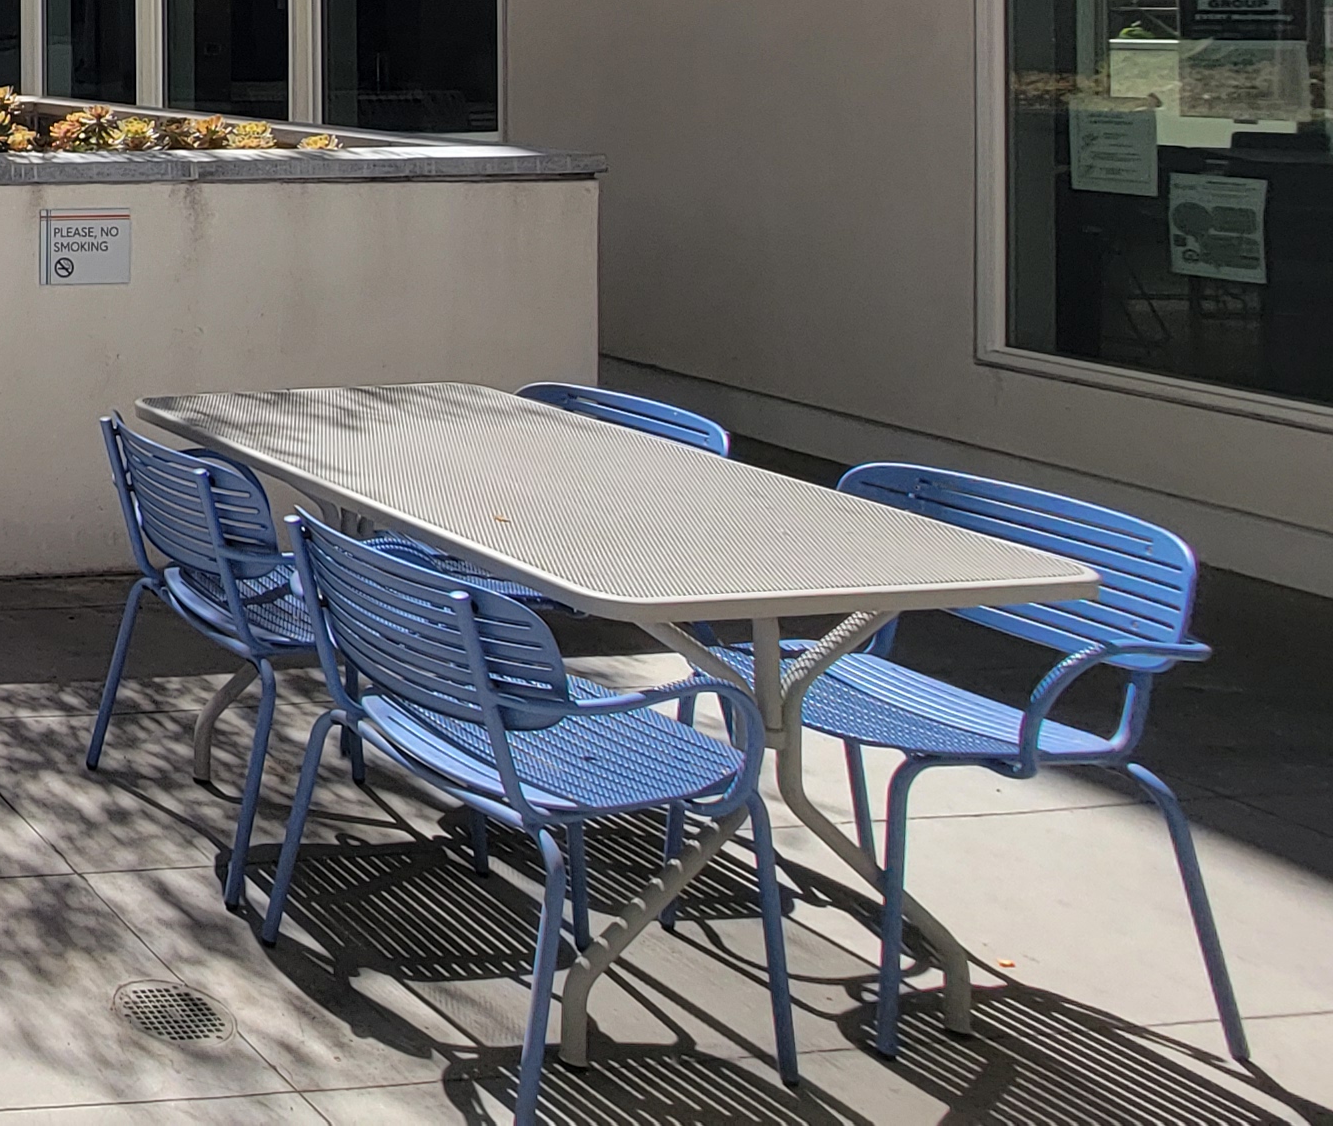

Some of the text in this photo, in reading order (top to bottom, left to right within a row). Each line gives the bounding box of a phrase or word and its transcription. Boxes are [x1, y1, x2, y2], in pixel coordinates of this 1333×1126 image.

[1208, 0, 1269, 8] GROUP
[53, 226, 119, 239] PLEASE, NO
[53, 241, 109, 252] SMOKING
